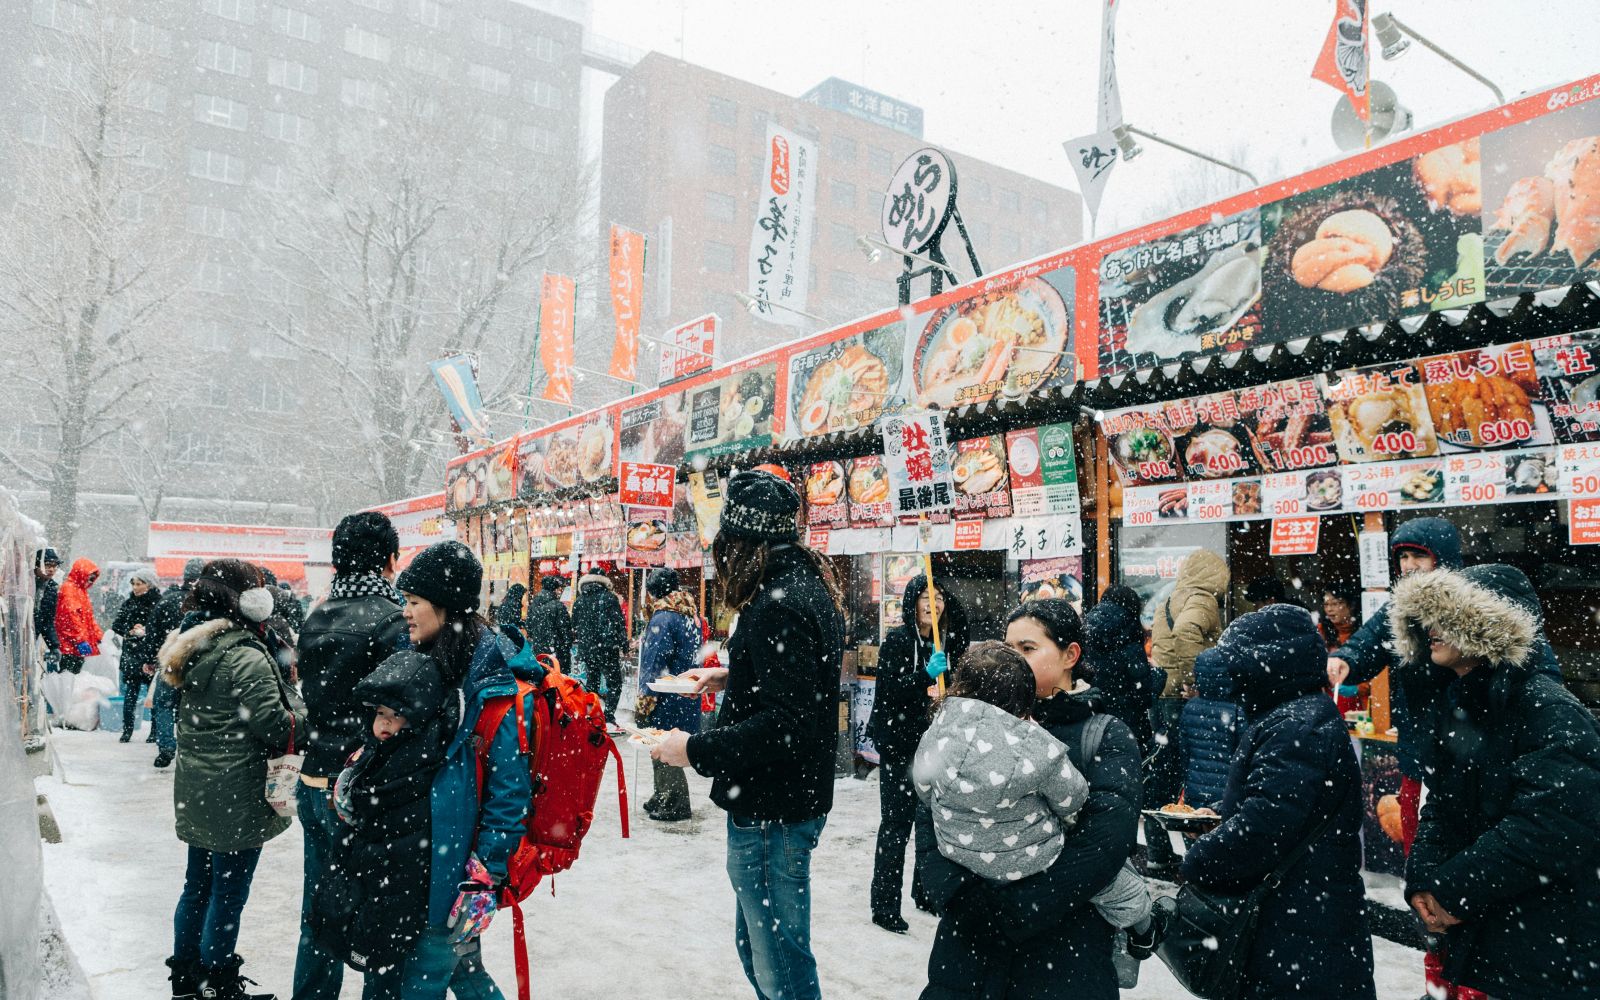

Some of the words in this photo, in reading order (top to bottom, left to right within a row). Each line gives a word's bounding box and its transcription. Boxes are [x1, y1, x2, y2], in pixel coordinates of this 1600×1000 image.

[849, 89, 908, 124] 北洋銀行
[888, 154, 942, 250] らーめん
[1106, 236, 1199, 279] あっけし名産
[1203, 222, 1240, 251] 牡蠣
[1400, 278, 1476, 309] 蒸しうに
[1201, 325, 1254, 350] 蒸しかき
[1424, 347, 1529, 384] 蒸しうに
[1241, 380, 1320, 410] 焼かに足
[901, 421, 944, 482] 牡蠣
[963, 439, 992, 451] ラーメン
[626, 464, 671, 479] ラーメン
[1348, 466, 1395, 481] つぶ串
[1449, 455, 1502, 473] 焼つぶ
[900, 482, 952, 511] 最後尾
[1276, 520, 1316, 537] ご注文
[273, 763, 301, 774] MICKEY
